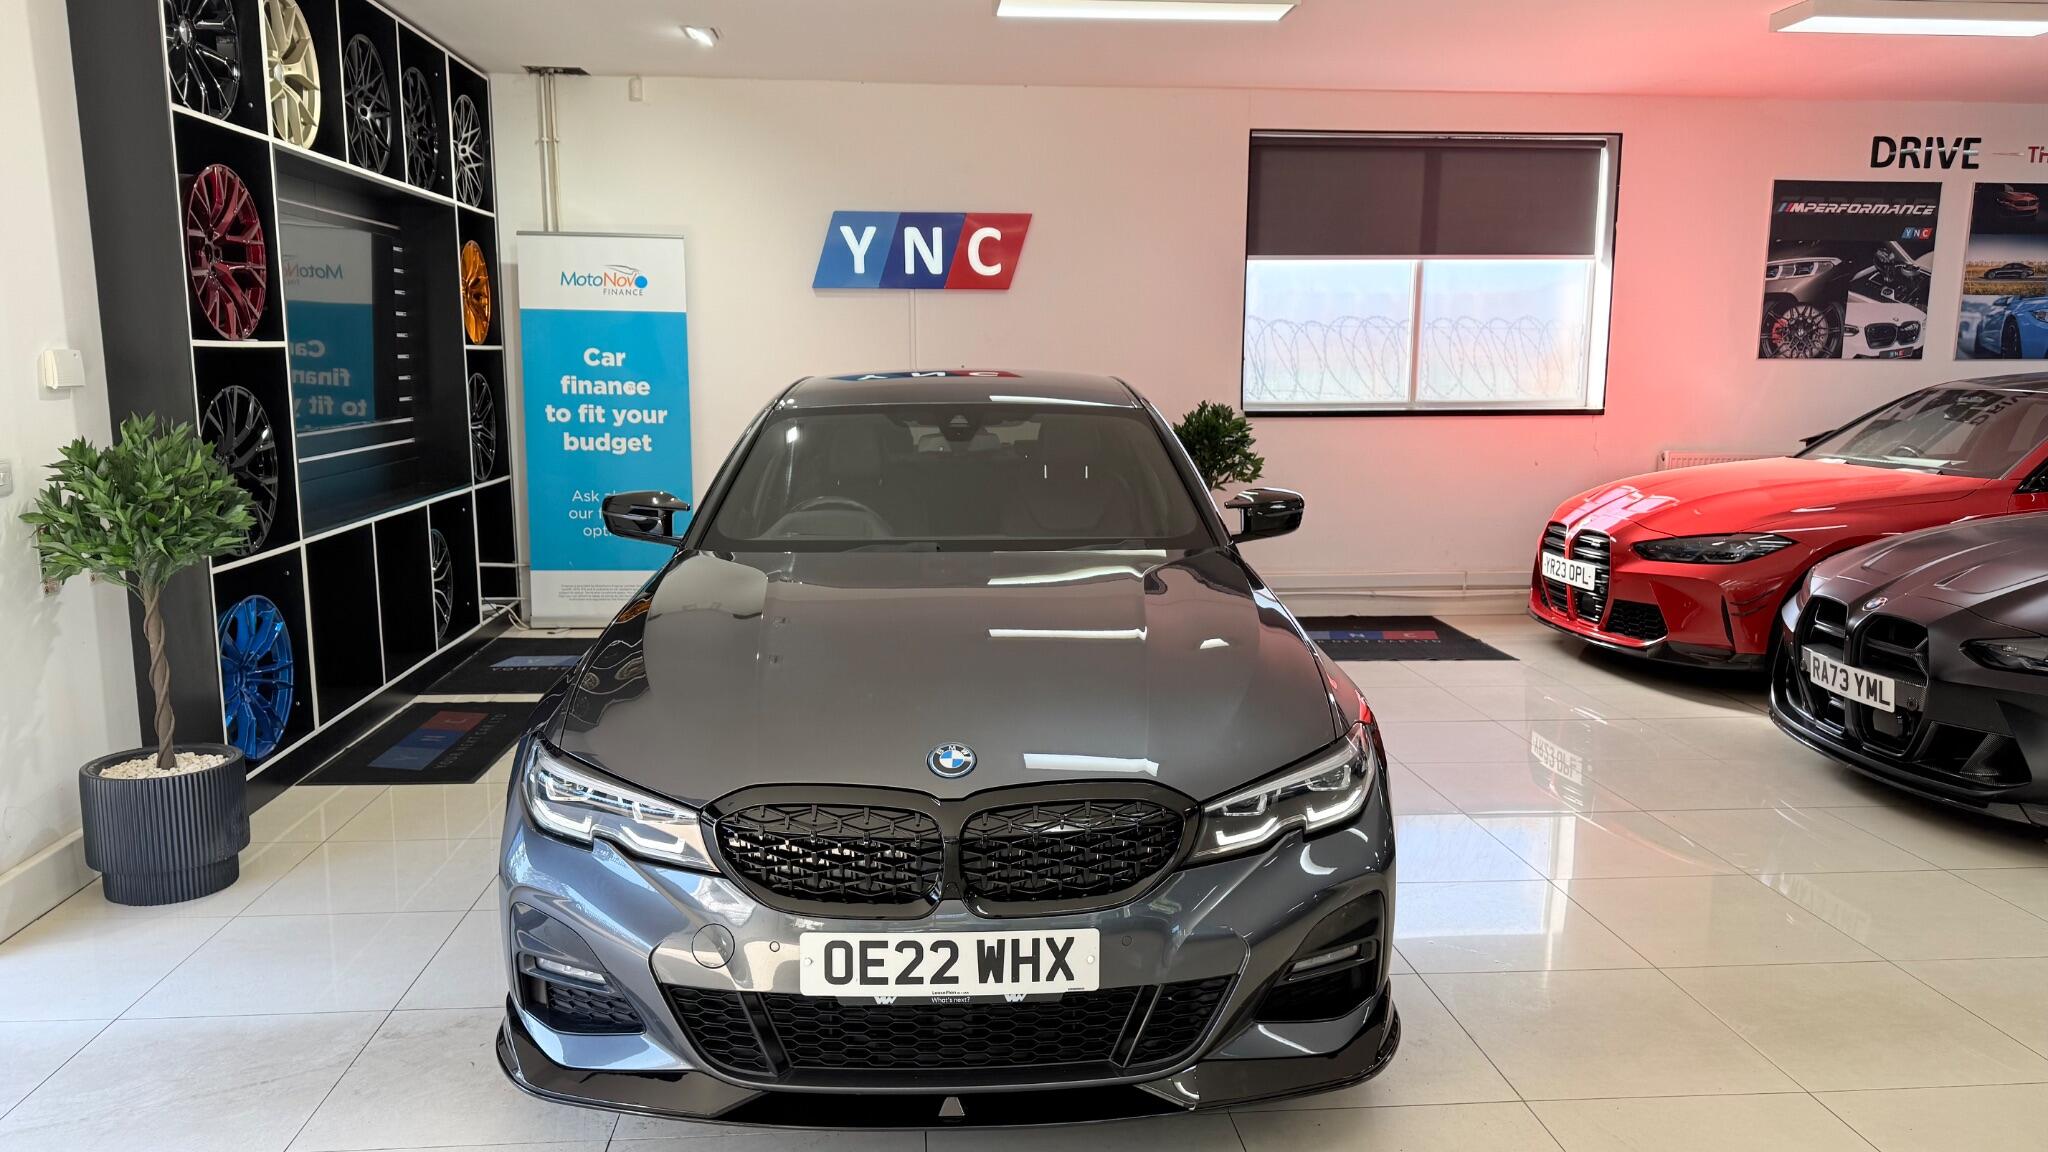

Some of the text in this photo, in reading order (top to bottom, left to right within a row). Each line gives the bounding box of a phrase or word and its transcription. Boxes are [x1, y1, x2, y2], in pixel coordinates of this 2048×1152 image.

[1870, 136, 1982, 169] DRIVE
[1904, 228, 1930, 238] YNC
[839, 225, 1002, 276] YNC
[603, 288, 644, 296] FINANCE
[583, 347, 626, 367] Car
[560, 375, 651, 396] finance
[545, 403, 668, 427] to fit your
[563, 432, 653, 455] budget
[572, 490, 600, 502] Ask
[569, 509, 594, 519] our
[1545, 556, 1589, 585] YR23 OPL
[1812, 655, 1891, 706] RA73 YML
[823, 936, 1075, 986] OE22 WHX
